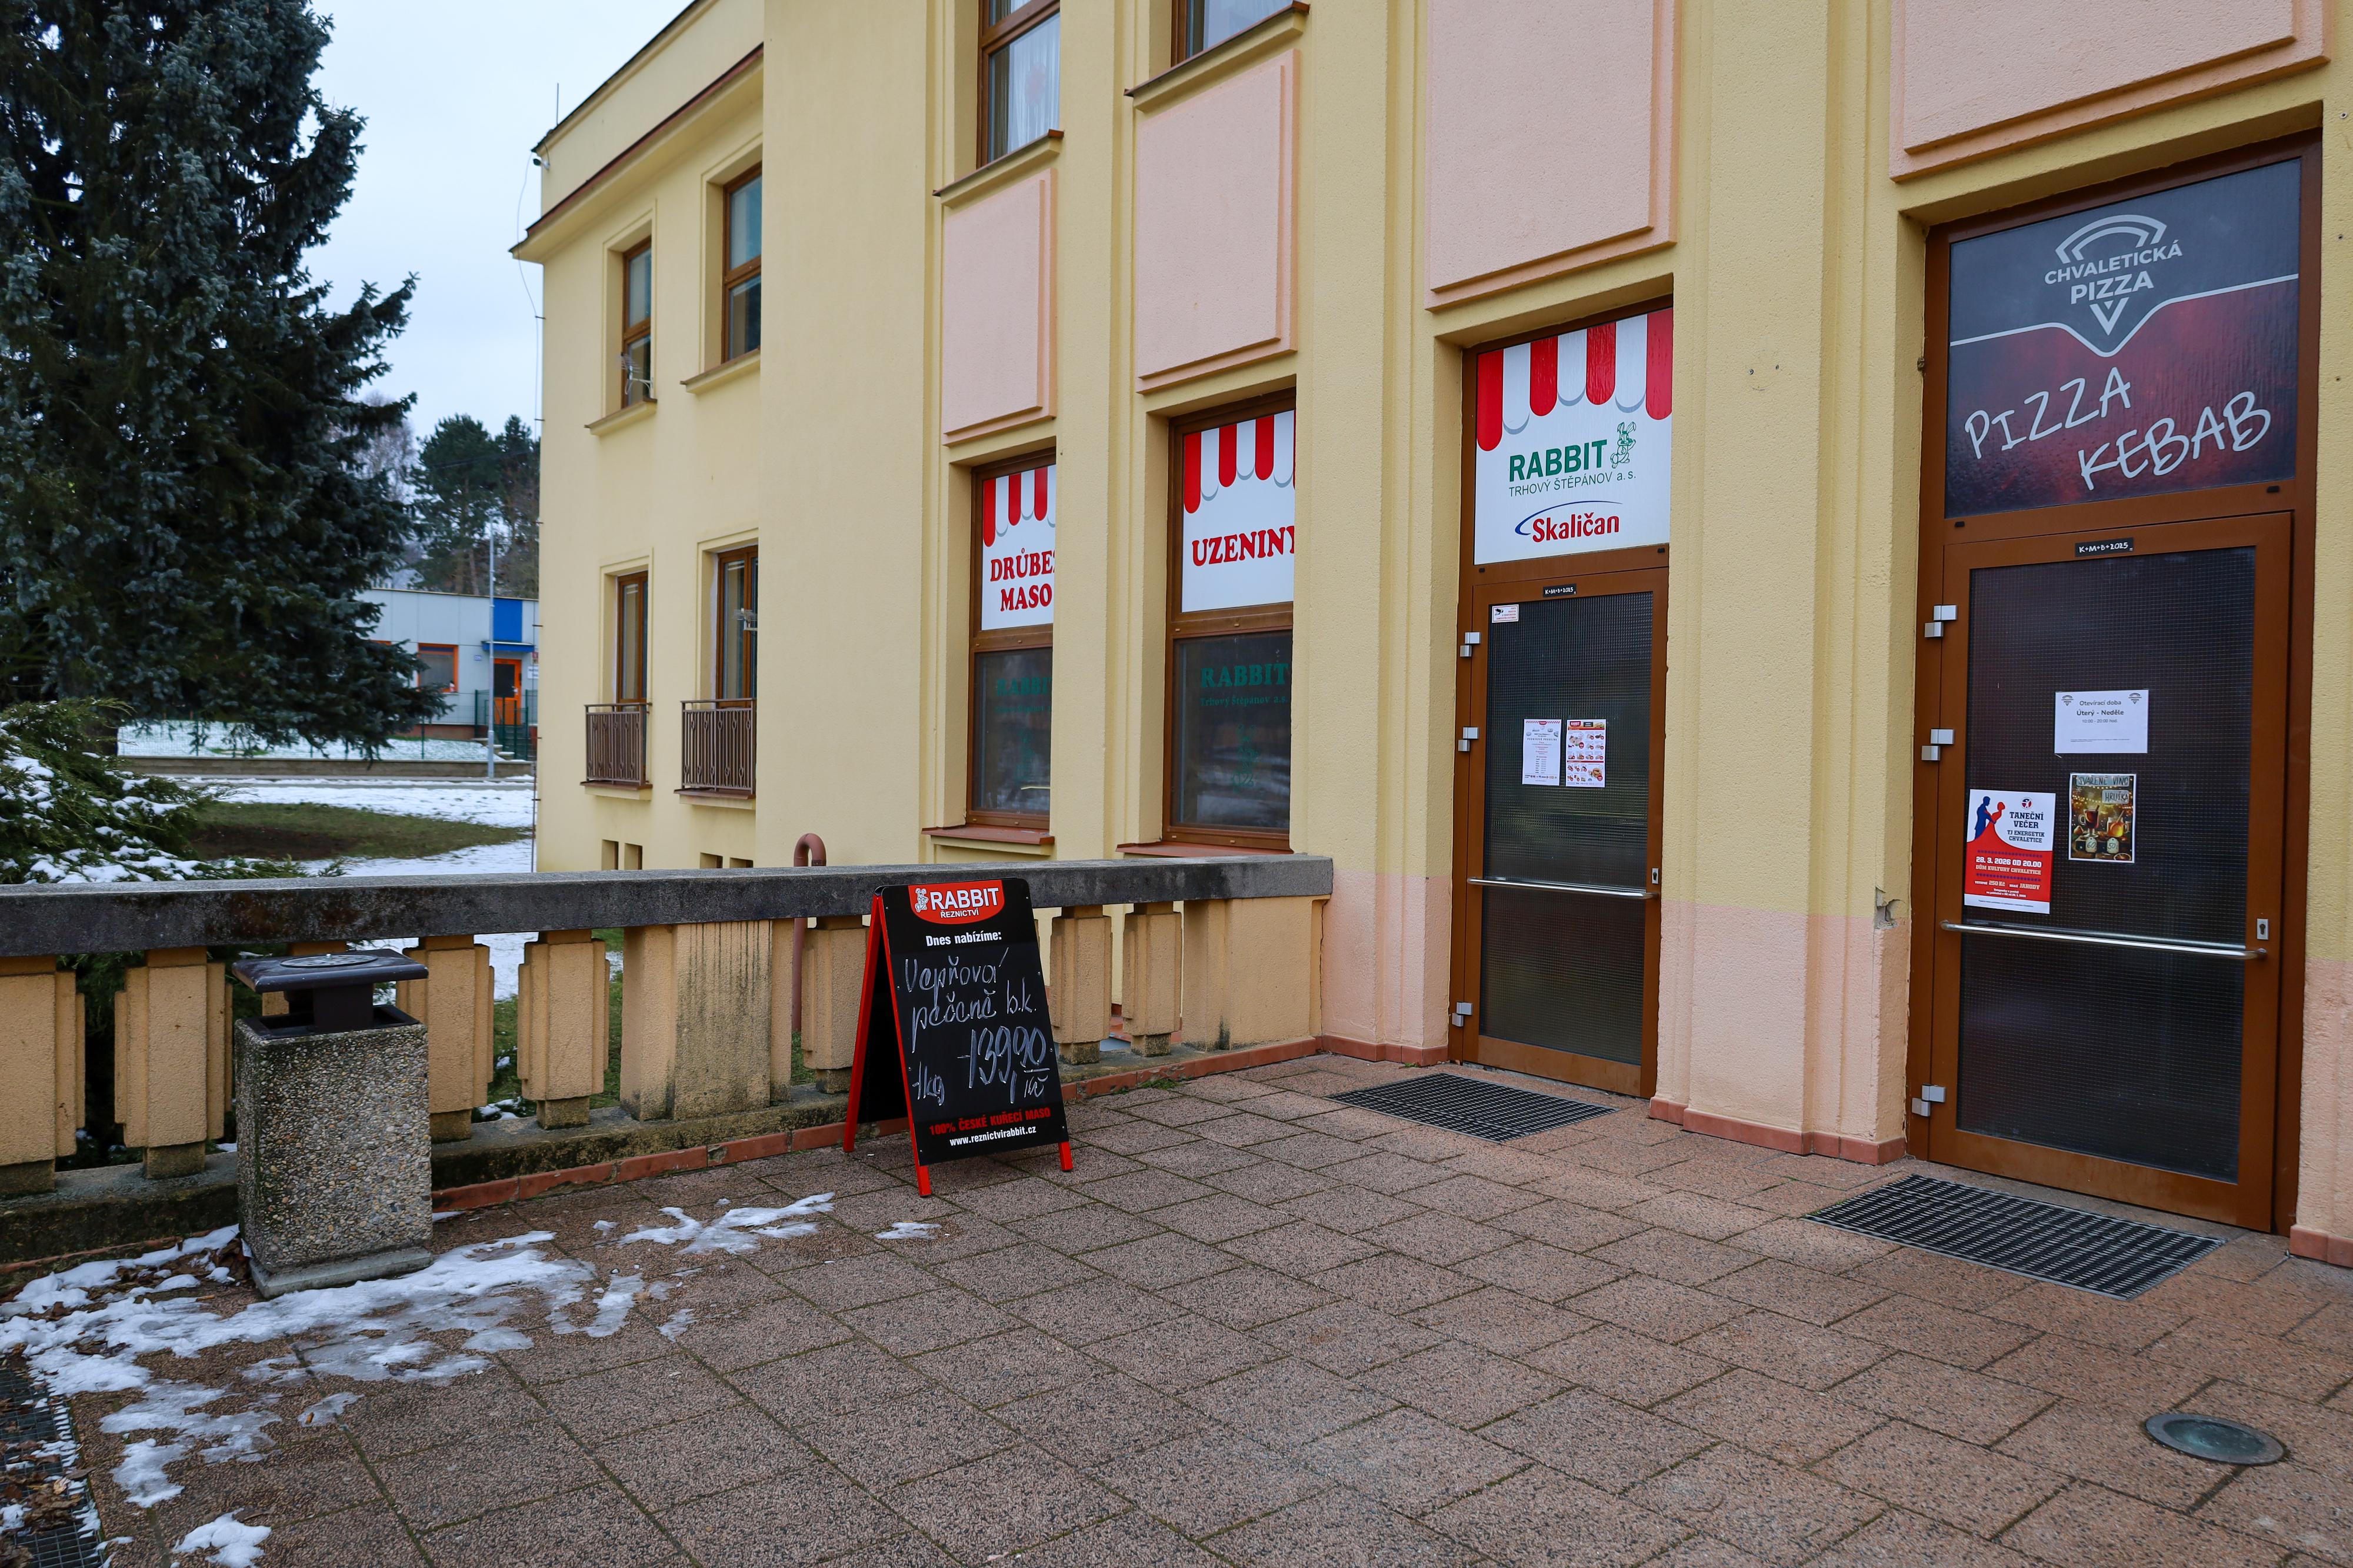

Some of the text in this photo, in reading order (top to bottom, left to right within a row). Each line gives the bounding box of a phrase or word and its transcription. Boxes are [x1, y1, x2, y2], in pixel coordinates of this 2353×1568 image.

[2044, 239, 2183, 285] CHVALETICKÁ
[2069, 270, 2154, 305] PIZZA
[1964, 366, 2131, 460] PIZZA
[2078, 391, 2272, 491] KEBAB
[1509, 439, 1608, 482] RABBIT
[1508, 479, 1551, 498] TRHOVÝ
[1554, 472, 1613, 491] ŠTĚPÁNOV
[1532, 512, 1619, 543] Skaličan
[989, 547, 1055, 582] DRŮBE
[1000, 583, 1052, 612] MASO
[996, 676, 1052, 697] RABBI
[1199, 663, 1291, 688] RABBIT
[2077, 709, 2095, 717] Úterý
[2105, 790, 2128, 802] HRUŠKA
[2009, 811, 2044, 820] TANEČNÍ
[2014, 820, 2039, 829] VEČER
[2022, 860, 2042, 868] 20.00
[930, 888, 999, 910] RABBIT
[940, 908, 979, 919] ŘEZNICTVÍ
[925, 930, 1002, 947] Dnes nabízíme:
[929, 1106, 1051, 1136] 100% ČESKÉ KUŘECÍ MASO
[949, 1125, 1037, 1147] www.reznictvirabbit.cz
